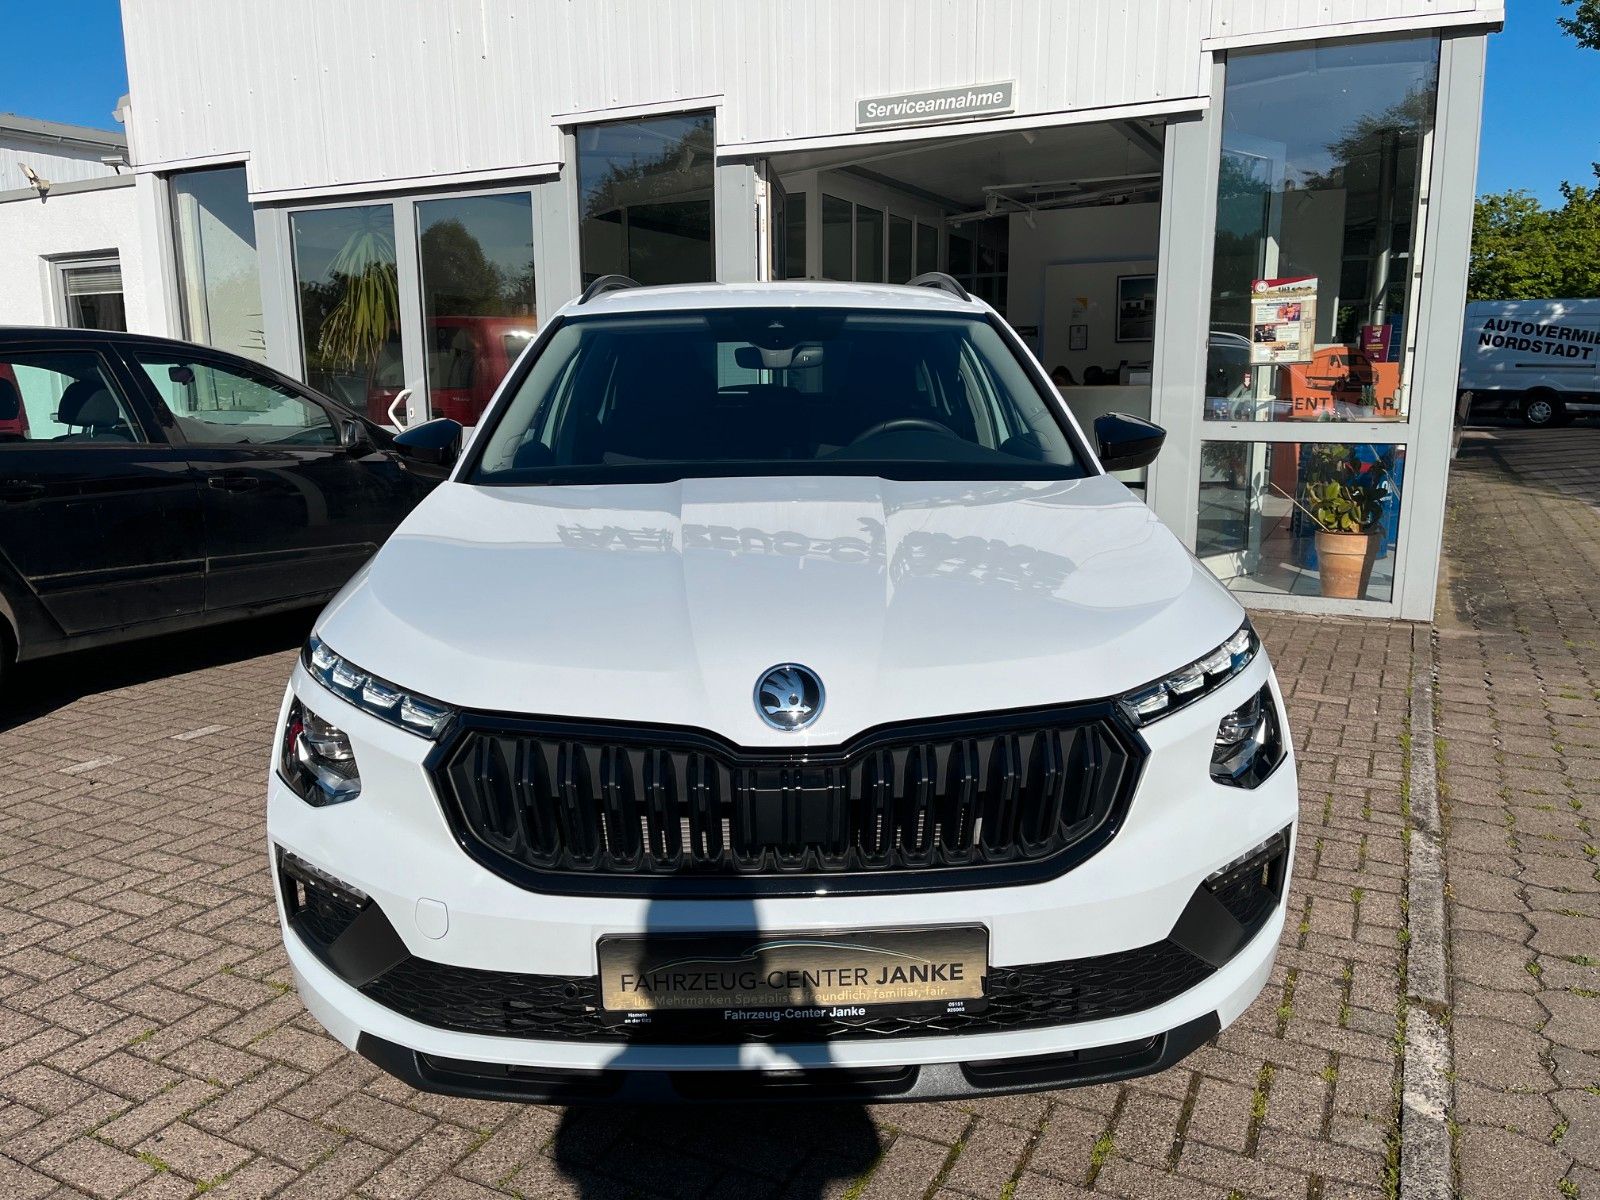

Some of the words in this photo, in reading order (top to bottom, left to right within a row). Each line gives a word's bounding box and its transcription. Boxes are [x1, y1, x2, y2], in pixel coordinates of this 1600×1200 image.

[866, 91, 1003, 118] Serviceannahme
[1478, 333, 1593, 360] NORDSTADT
[1294, 397, 1330, 410] ENT
[620, 967, 868, 992] FAHRZEUG-CENTER
[876, 963, 964, 985] JANKE
[652, 993, 731, 1007] Mehrmarken
[873, 985, 922, 1000] familiär,
[926, 984, 948, 996] fair.
[724, 1006, 826, 1021] Fahrzeug-Center
[829, 1006, 866, 1017] Janke
